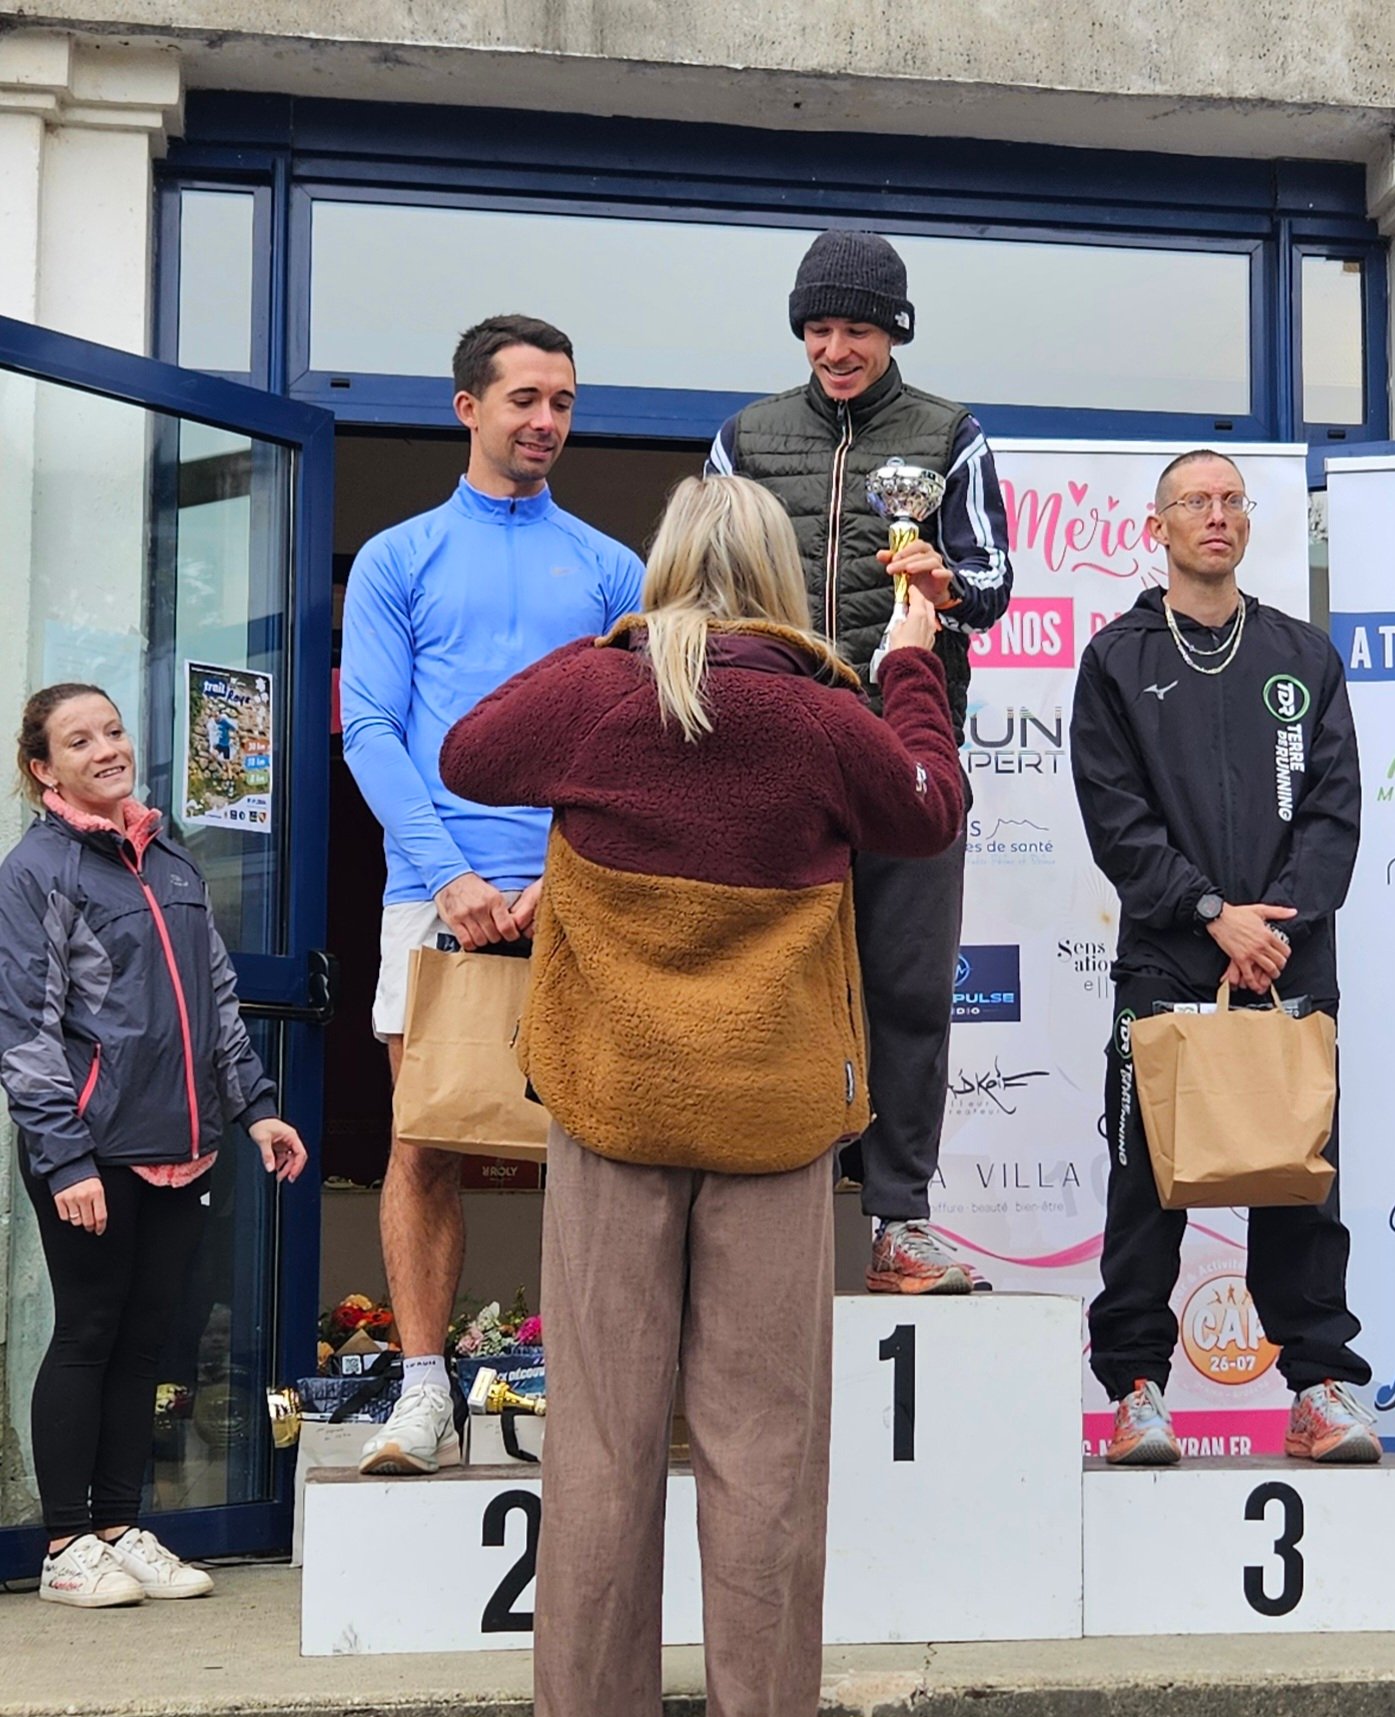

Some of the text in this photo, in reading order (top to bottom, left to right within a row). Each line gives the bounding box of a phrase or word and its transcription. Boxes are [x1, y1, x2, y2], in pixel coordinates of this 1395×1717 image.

[1000, 480, 1160, 572] Merci
[1000, 611, 1062, 656] NOS
[1277, 683, 1296, 717] TDR
[968, 751, 1064, 774] PERT
[1287, 723, 1305, 773] TERRE
[1275, 730, 1293, 822] DE RUNNING
[986, 840, 1006, 853] de
[1010, 839, 1054, 853] santé
[1057, 939, 1105, 962] Sens
[976, 1162, 1080, 1189] VILLA
[1210, 1356, 1257, 1372] 26-07
[879, 1324, 915, 1461] 1
[481, 1489, 541, 1633] 2
[1243, 1481, 1304, 1617] 3
